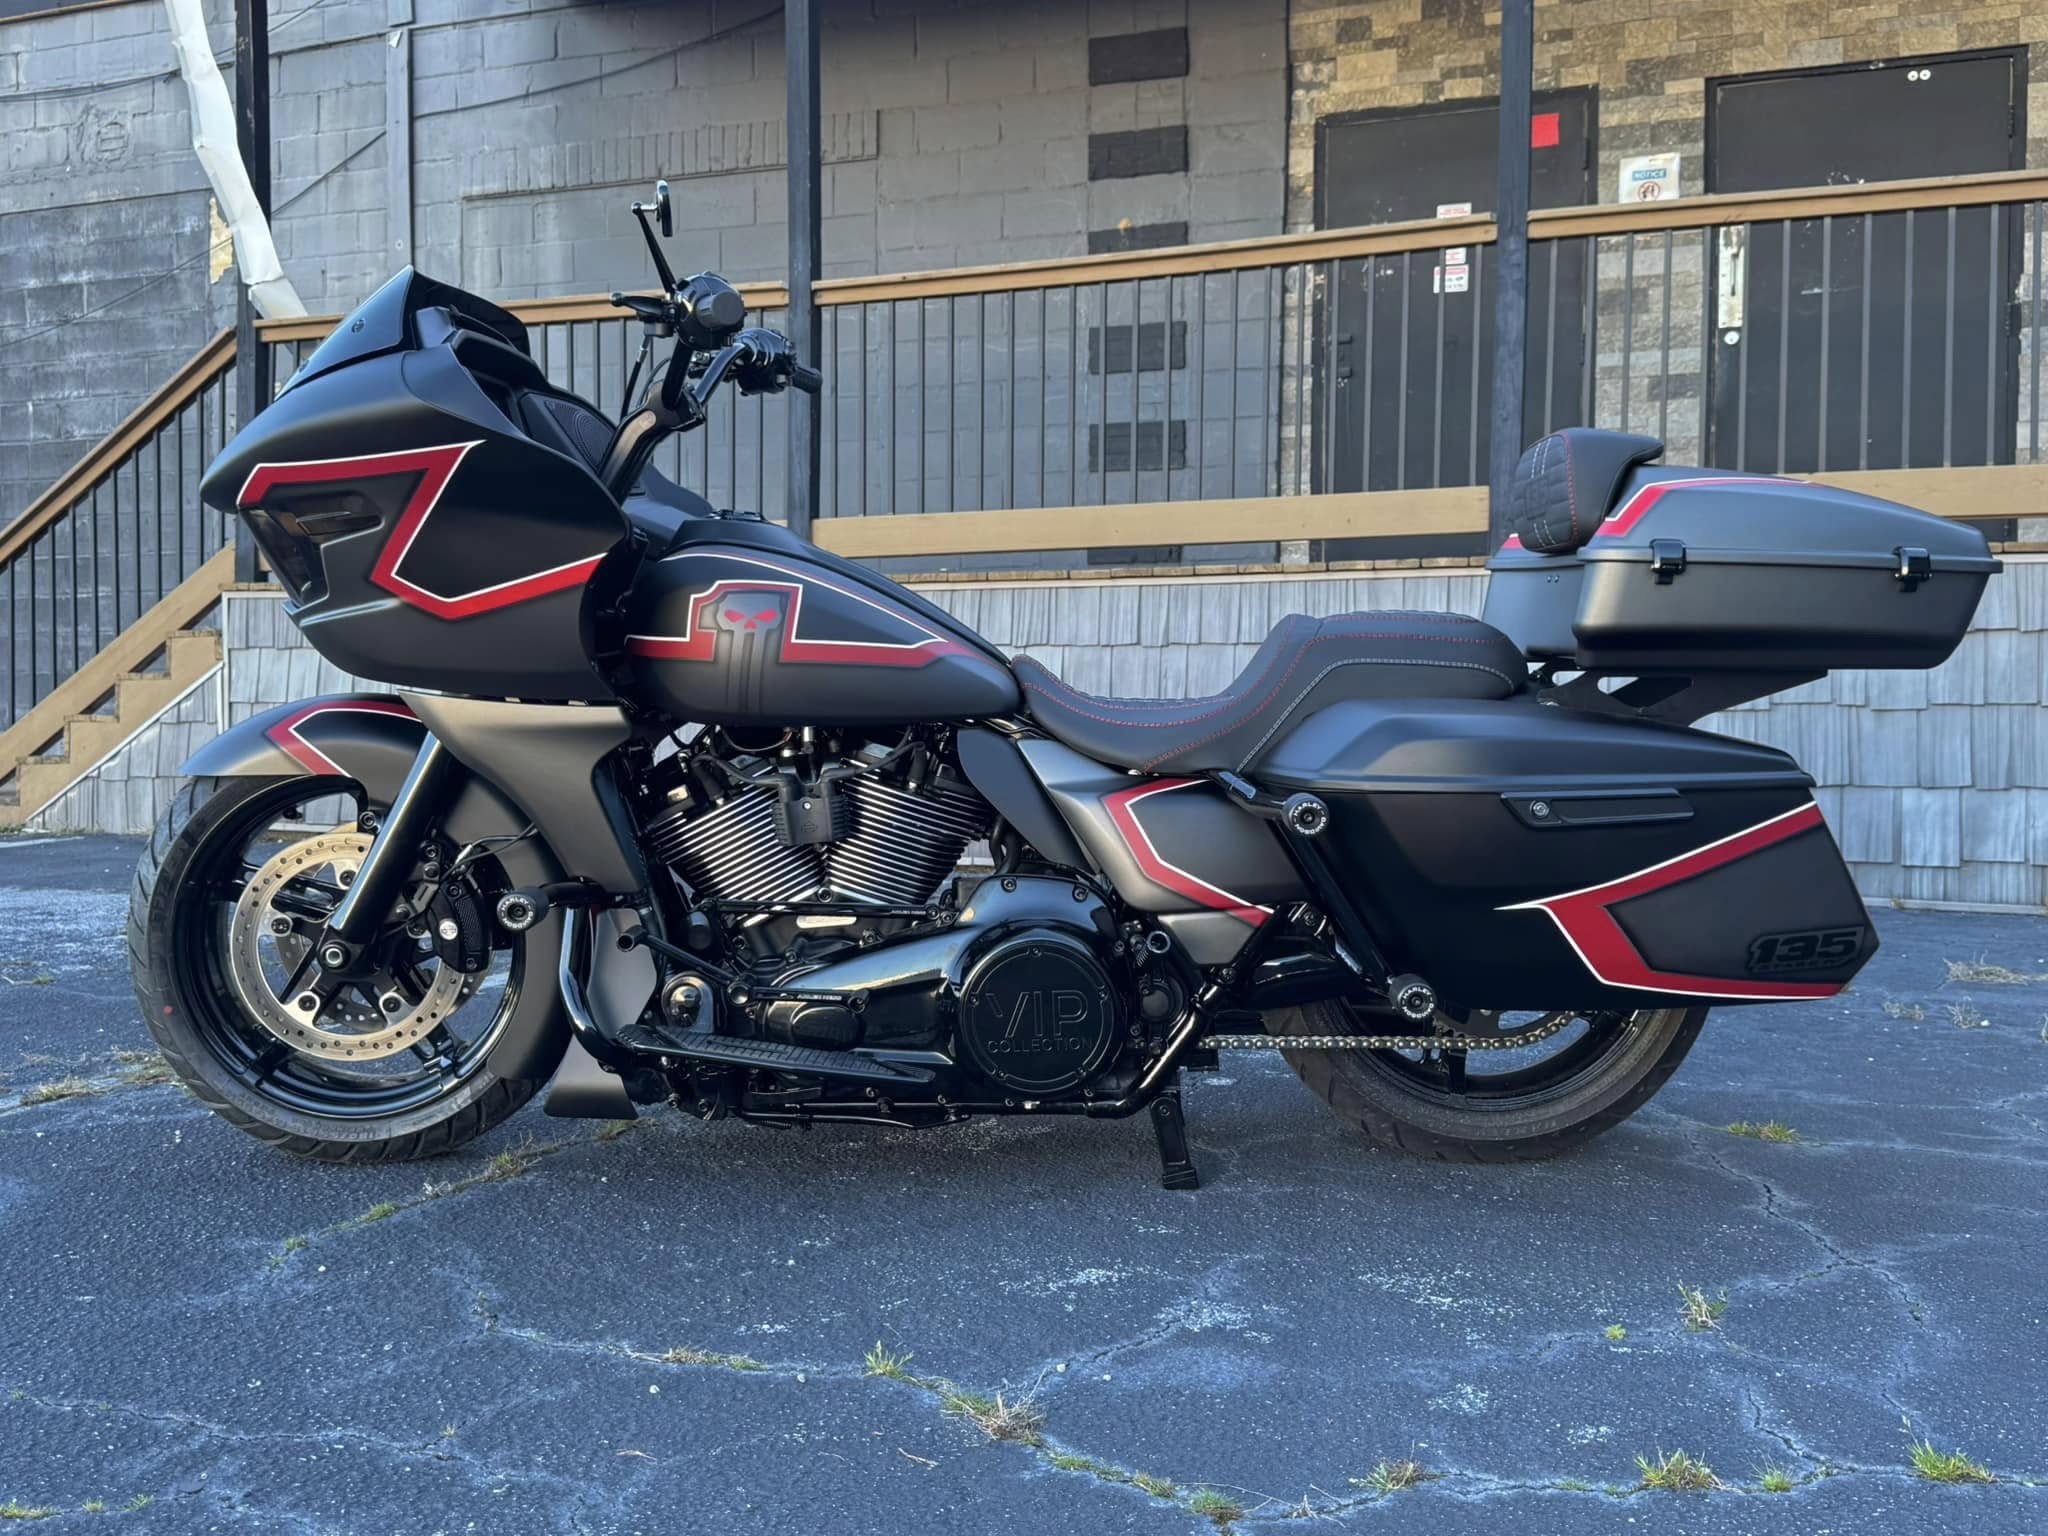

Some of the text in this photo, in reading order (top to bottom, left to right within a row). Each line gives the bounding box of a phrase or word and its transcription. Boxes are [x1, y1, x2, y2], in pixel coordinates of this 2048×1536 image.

[1634, 170, 1664, 179] NOTICE
[1293, 802, 1321, 816] HARLEY
[1751, 929, 1862, 964] 135
[1402, 986, 1432, 999] HARLEY
[985, 989, 1089, 1038] VIP
[987, 1037, 1092, 1053] COLLECTION
